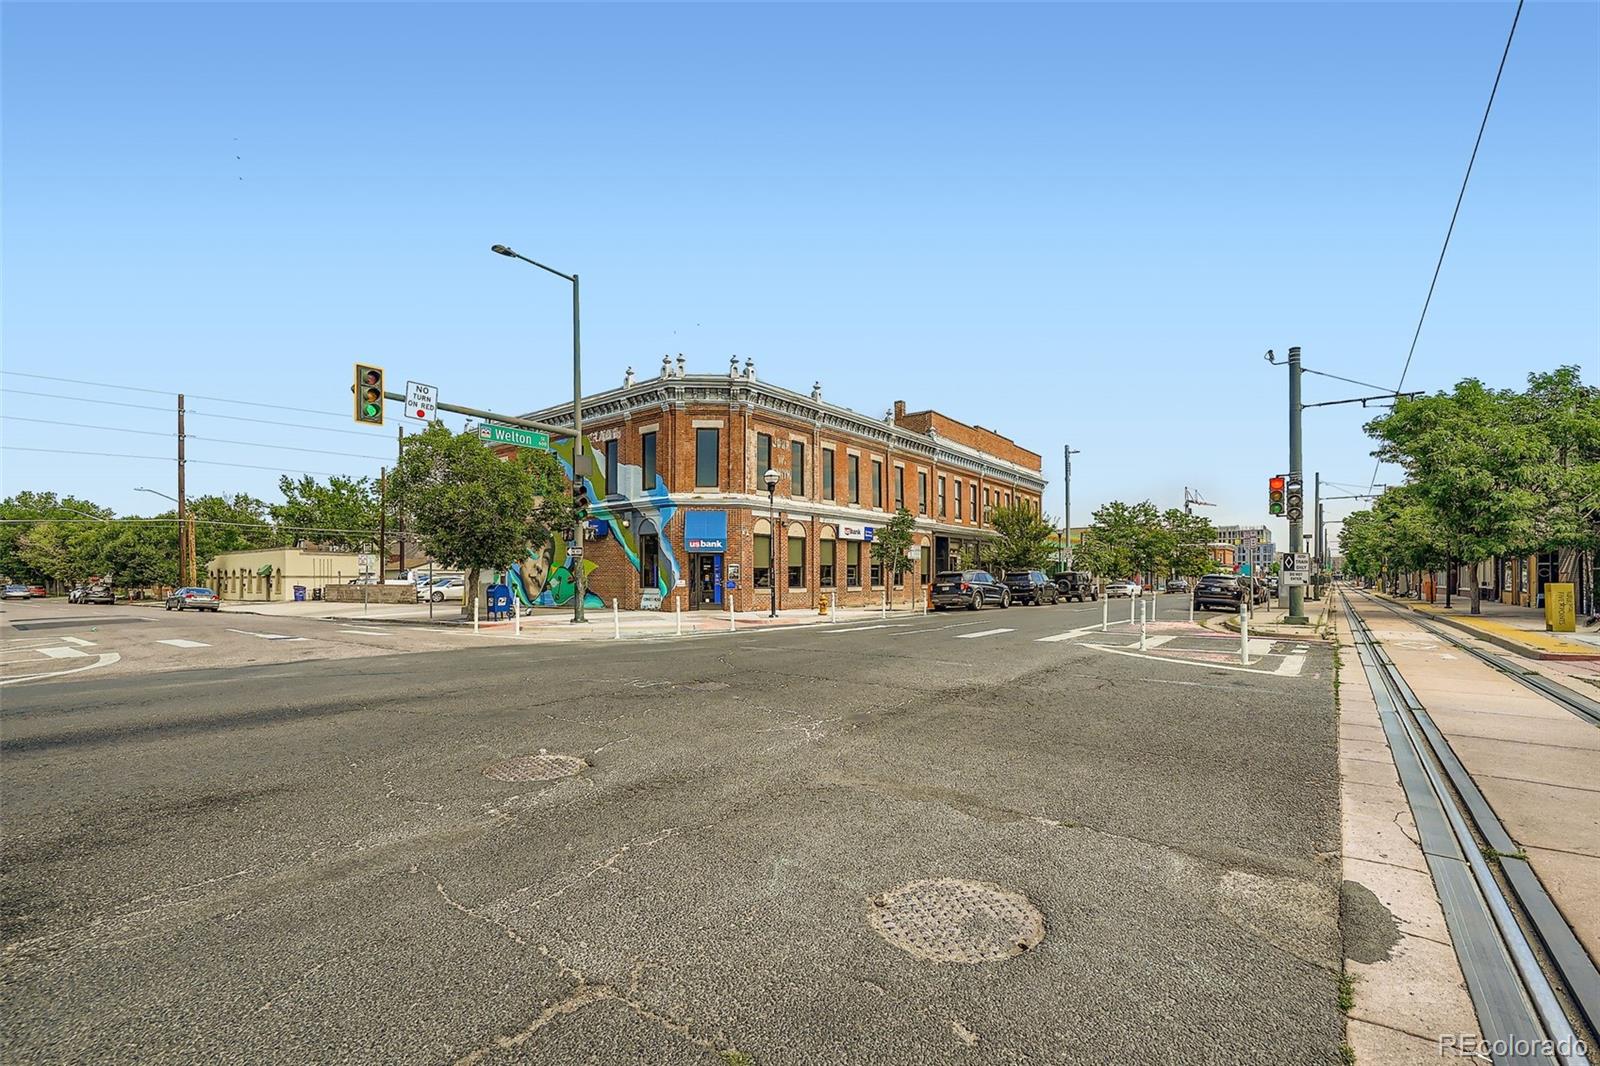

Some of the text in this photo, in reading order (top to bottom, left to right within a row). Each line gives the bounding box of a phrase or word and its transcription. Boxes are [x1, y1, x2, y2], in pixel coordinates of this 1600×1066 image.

[416, 385, 429, 394] NO
[413, 393, 431, 402] TURN
[421, 402, 434, 411] RED
[495, 429, 532, 445] Welton
